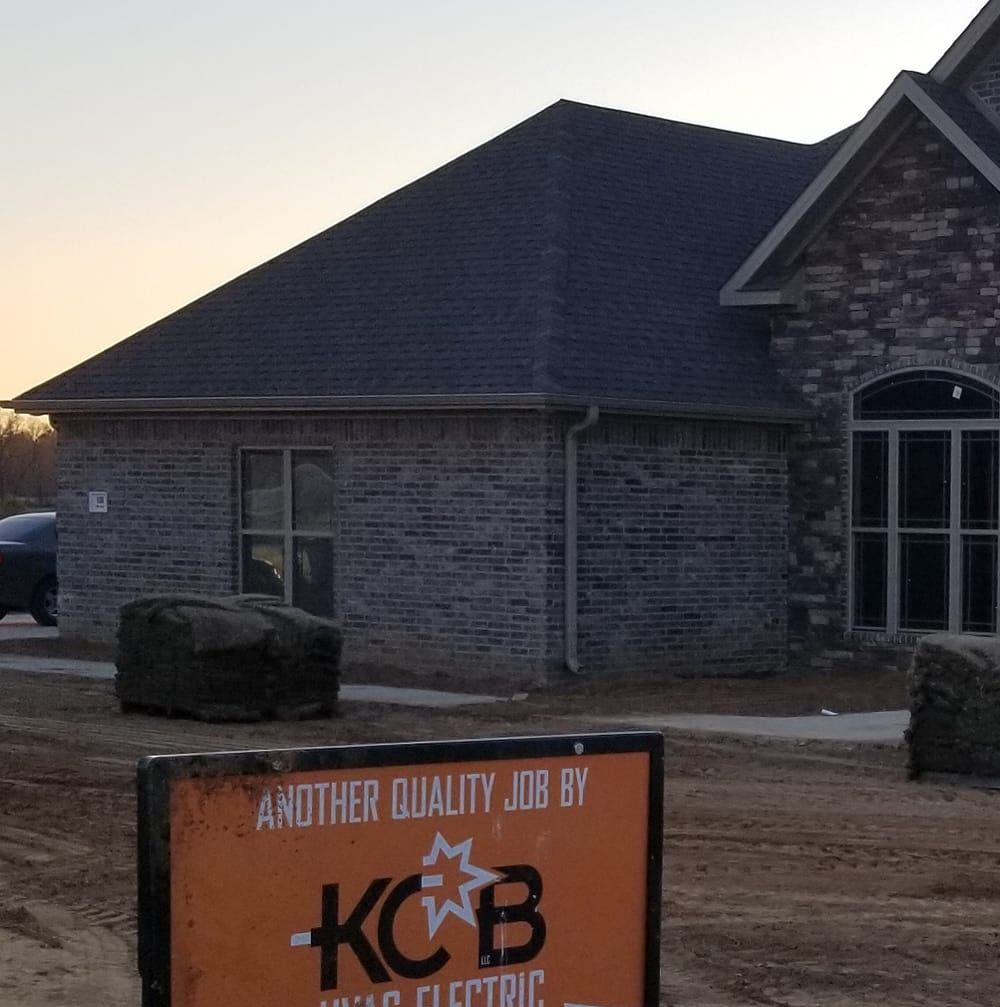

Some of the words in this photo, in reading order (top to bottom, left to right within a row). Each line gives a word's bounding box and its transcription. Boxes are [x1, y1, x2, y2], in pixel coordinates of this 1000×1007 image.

[256, 780, 379, 831] ANOTHER
[392, 772, 496, 820] QUALITY
[504, 769, 549, 812] JOB
[560, 767, 589, 808] BY
[480, 953, 491, 966] LLC
